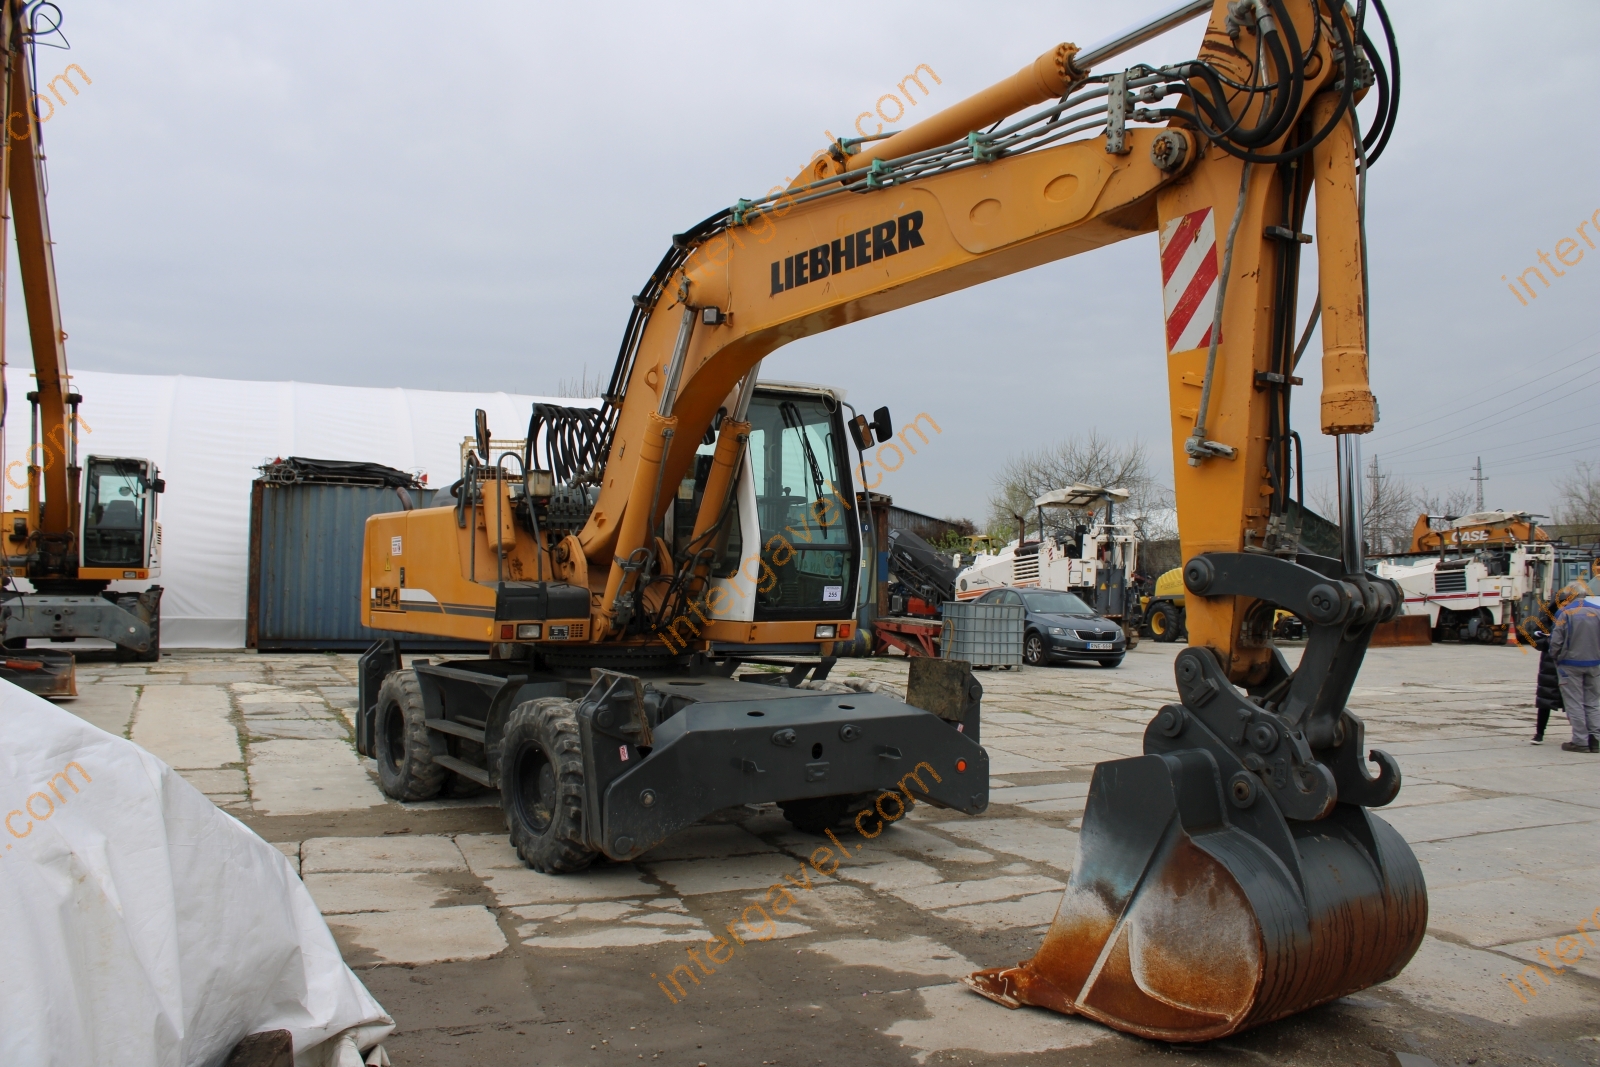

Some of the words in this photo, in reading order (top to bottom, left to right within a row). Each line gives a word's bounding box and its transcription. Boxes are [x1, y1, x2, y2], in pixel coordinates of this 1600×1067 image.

[771, 210, 925, 295] LIEBHERR
[1451, 530, 1489, 542] CASE
[375, 587, 399, 608] 924
